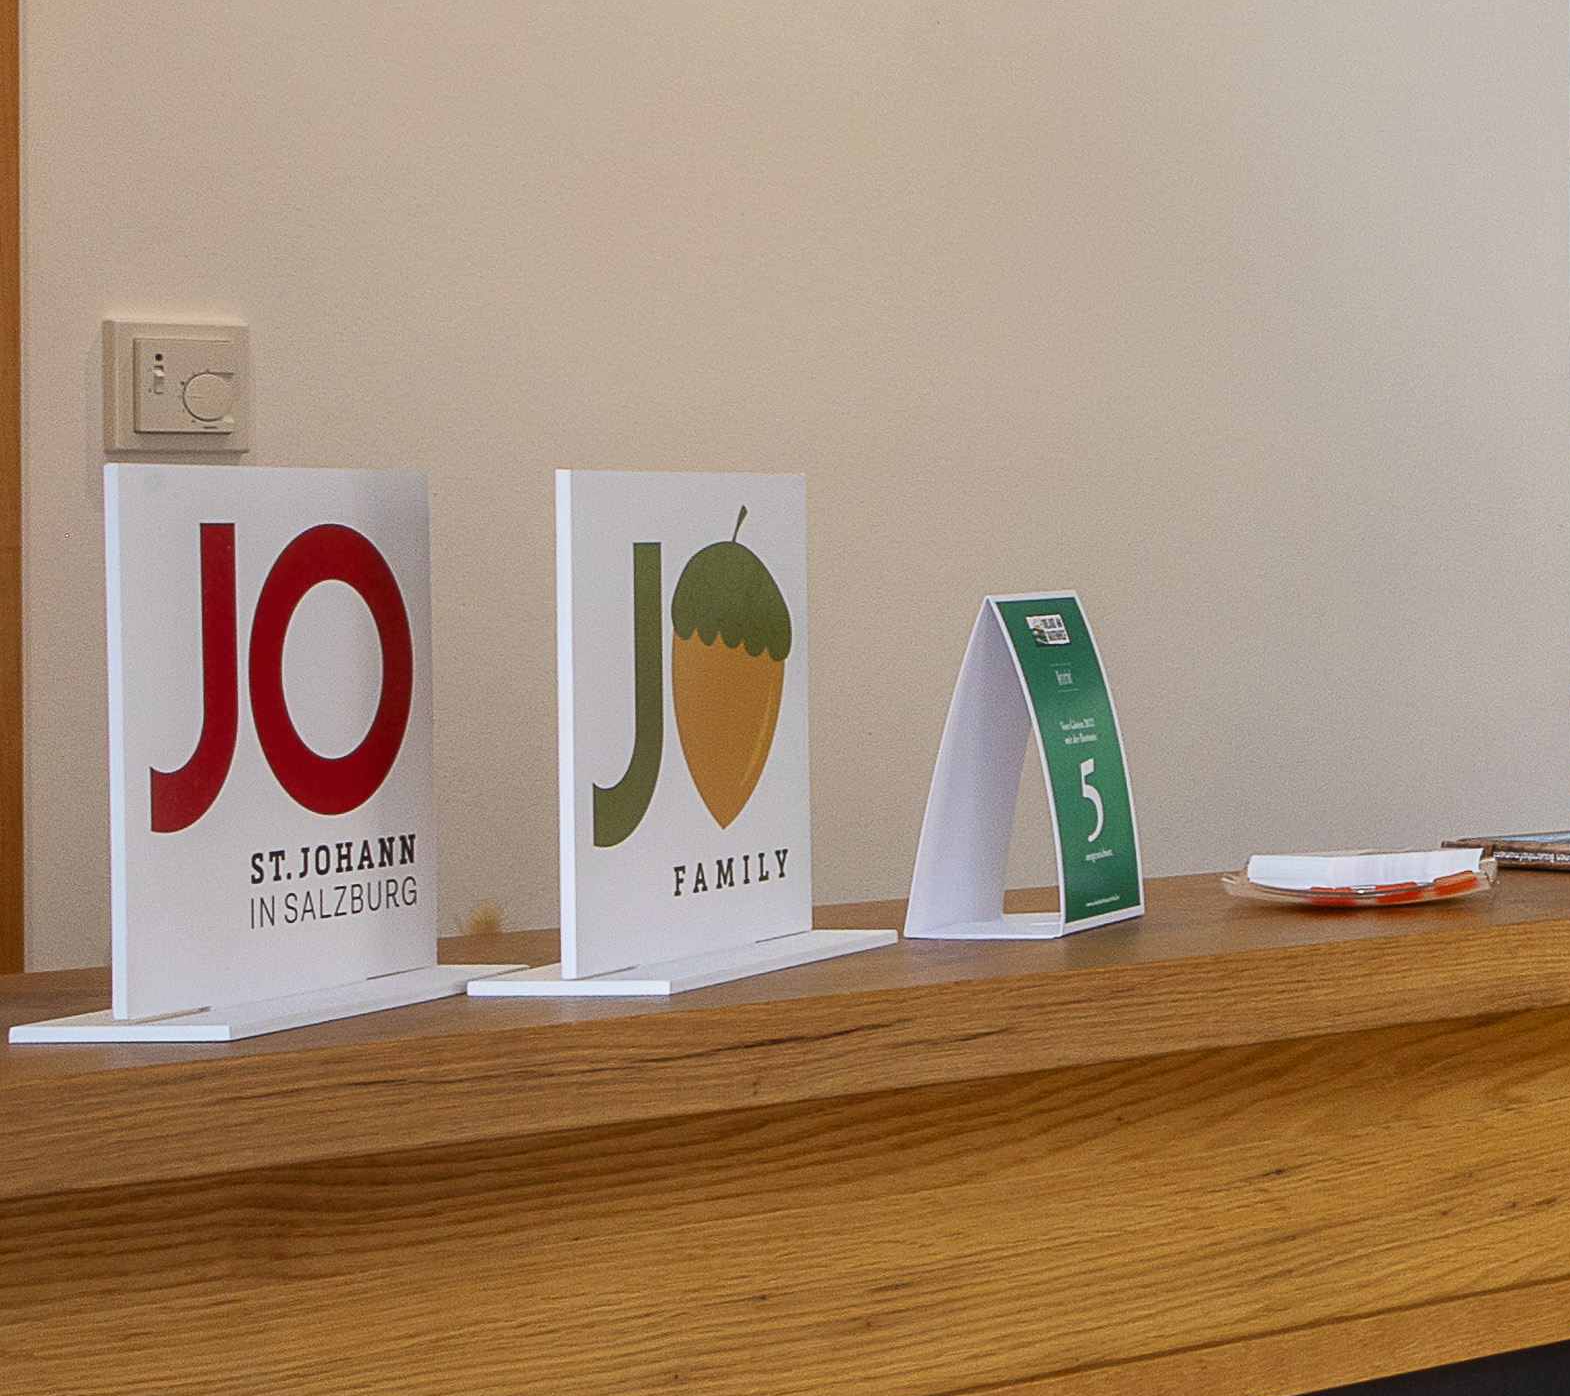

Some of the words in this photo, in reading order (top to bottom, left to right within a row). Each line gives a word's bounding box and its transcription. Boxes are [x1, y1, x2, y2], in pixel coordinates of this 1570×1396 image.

[150, 522, 414, 834] JO
[1080, 758, 1104, 843] 5
[251, 895, 275, 929] IN
[284, 876, 418, 924] SALZBURG
[674, 849, 789, 896] FAMILY
